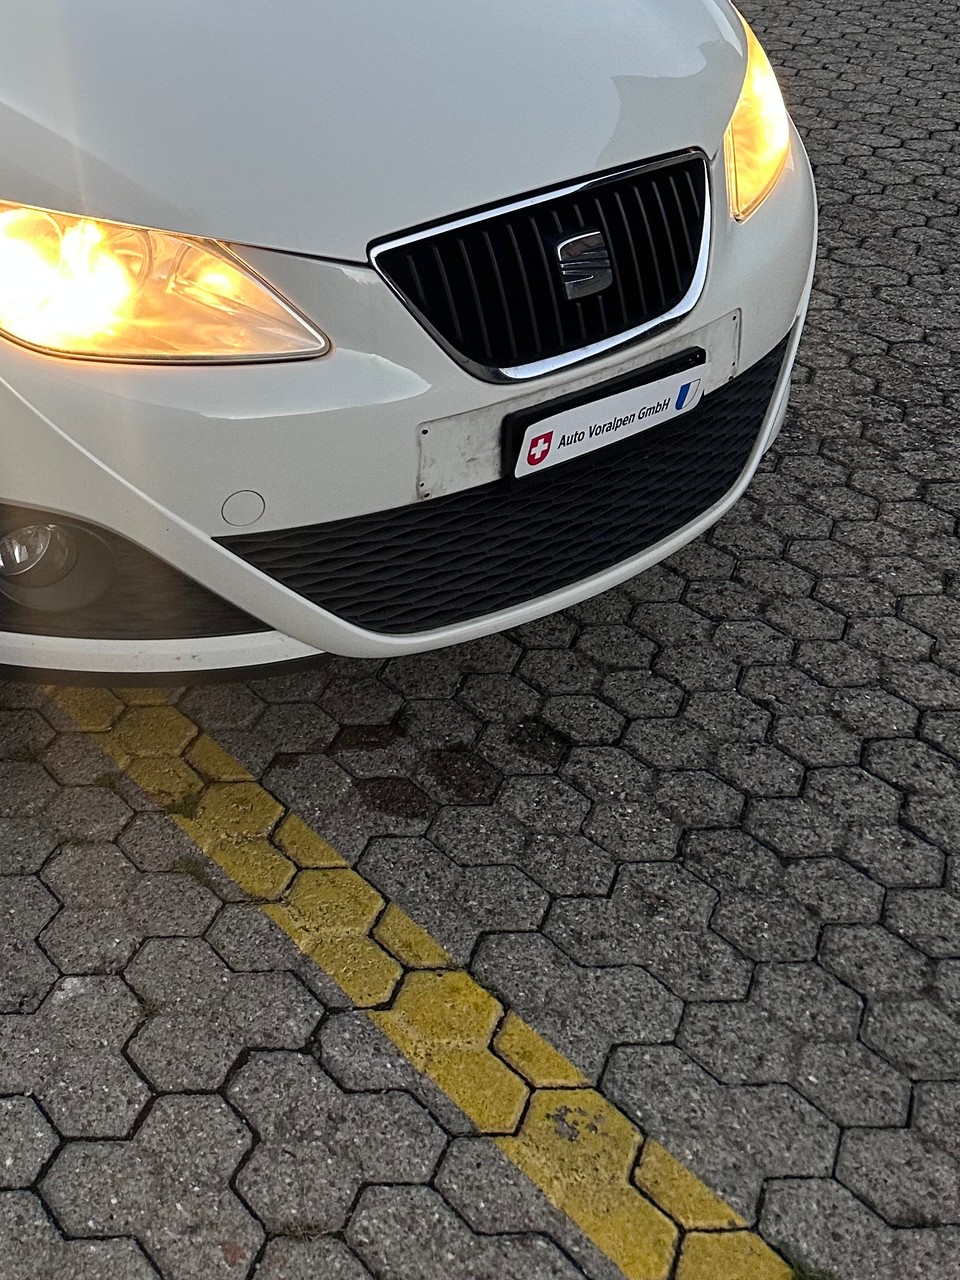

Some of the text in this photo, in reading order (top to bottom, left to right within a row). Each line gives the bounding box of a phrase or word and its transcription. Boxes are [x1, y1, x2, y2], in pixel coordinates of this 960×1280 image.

[557, 398, 671, 449] Auto Voralpen GmbH
